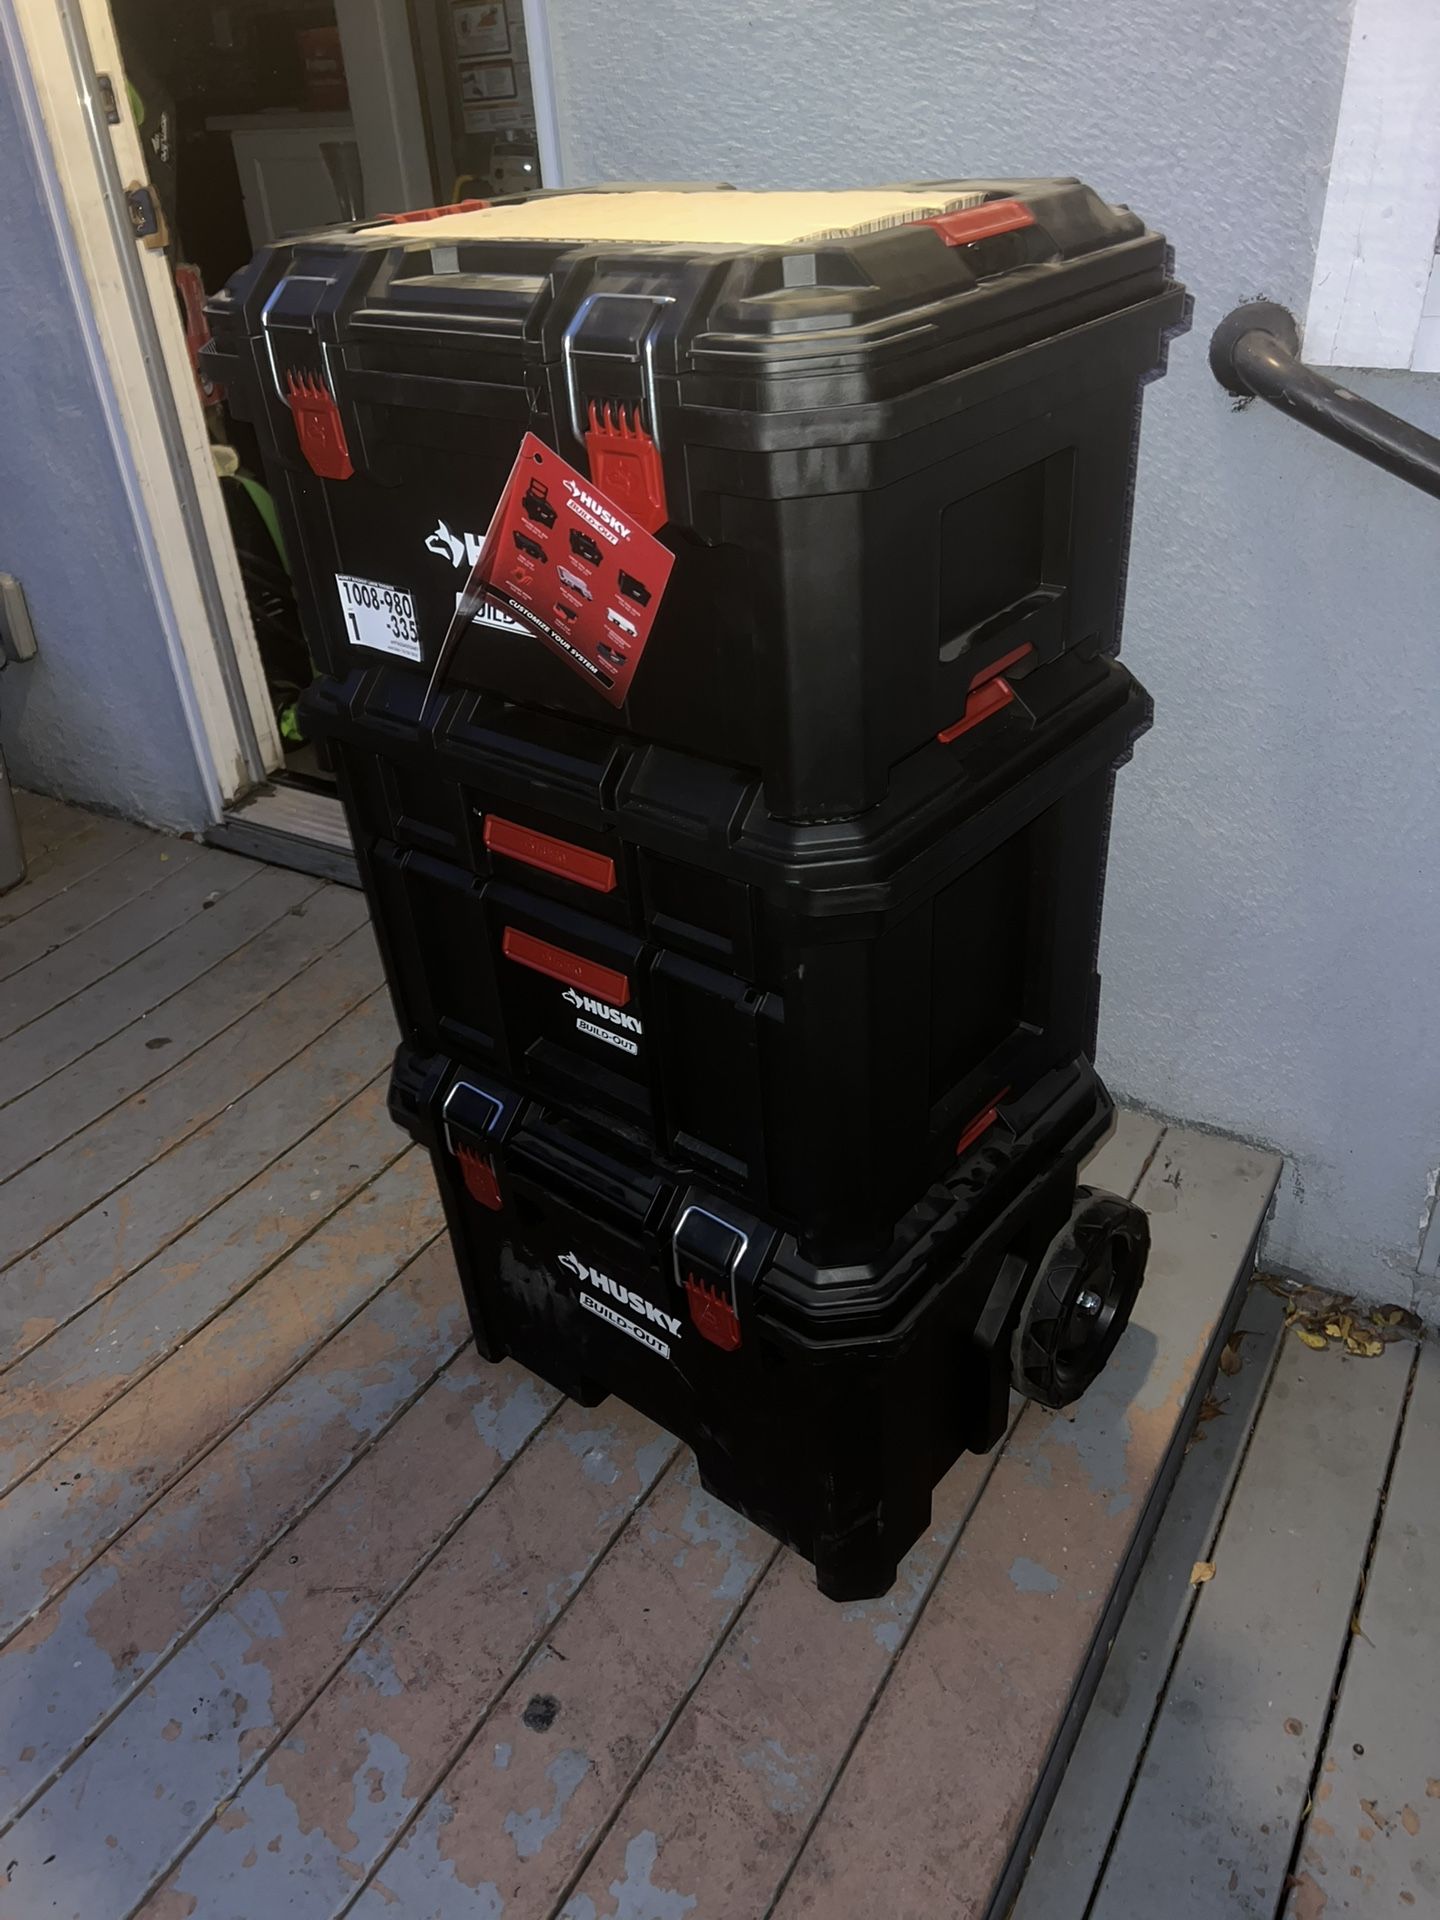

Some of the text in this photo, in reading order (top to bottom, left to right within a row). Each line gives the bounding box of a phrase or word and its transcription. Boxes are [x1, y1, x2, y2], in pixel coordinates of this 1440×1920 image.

[568, 501, 617, 542] BUILD-OUT
[580, 491, 631, 538] HUSKY
[343, 582, 412, 619] 1008-980
[348, 612, 360, 641] 1
[508, 599, 551, 633] CUSTOMIZE
[551, 631, 571, 650] YOUR
[570, 648, 599, 674] SYSTEM
[578, 1020, 635, 1051] BUILD-OUT
[582, 996, 643, 1035] HUSKY
[588, 1266, 682, 1336] HUSKY
[583, 1296, 666, 1352] BUILD-OUT
